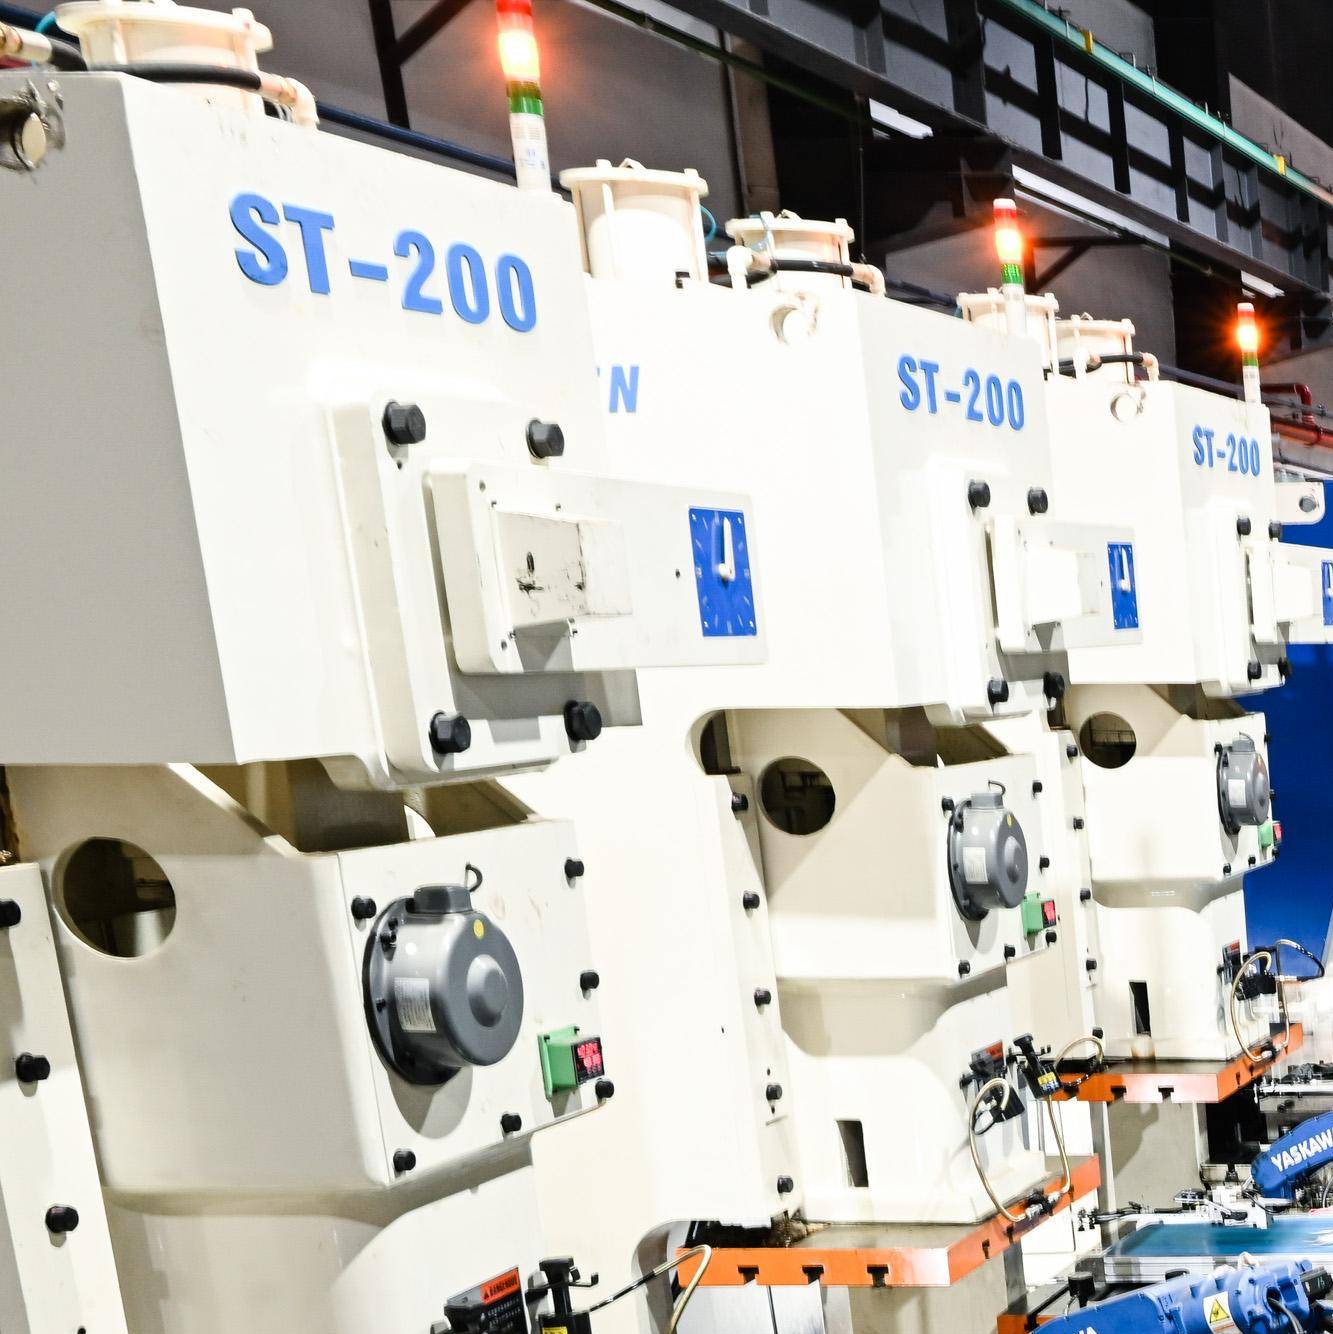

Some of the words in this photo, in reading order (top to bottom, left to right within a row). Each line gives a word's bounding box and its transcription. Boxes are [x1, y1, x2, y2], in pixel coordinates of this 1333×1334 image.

[230, 193, 537, 333] ST-200
[897, 353, 1025, 431] ST-200
[1193, 424, 1260, 477] ST-200
